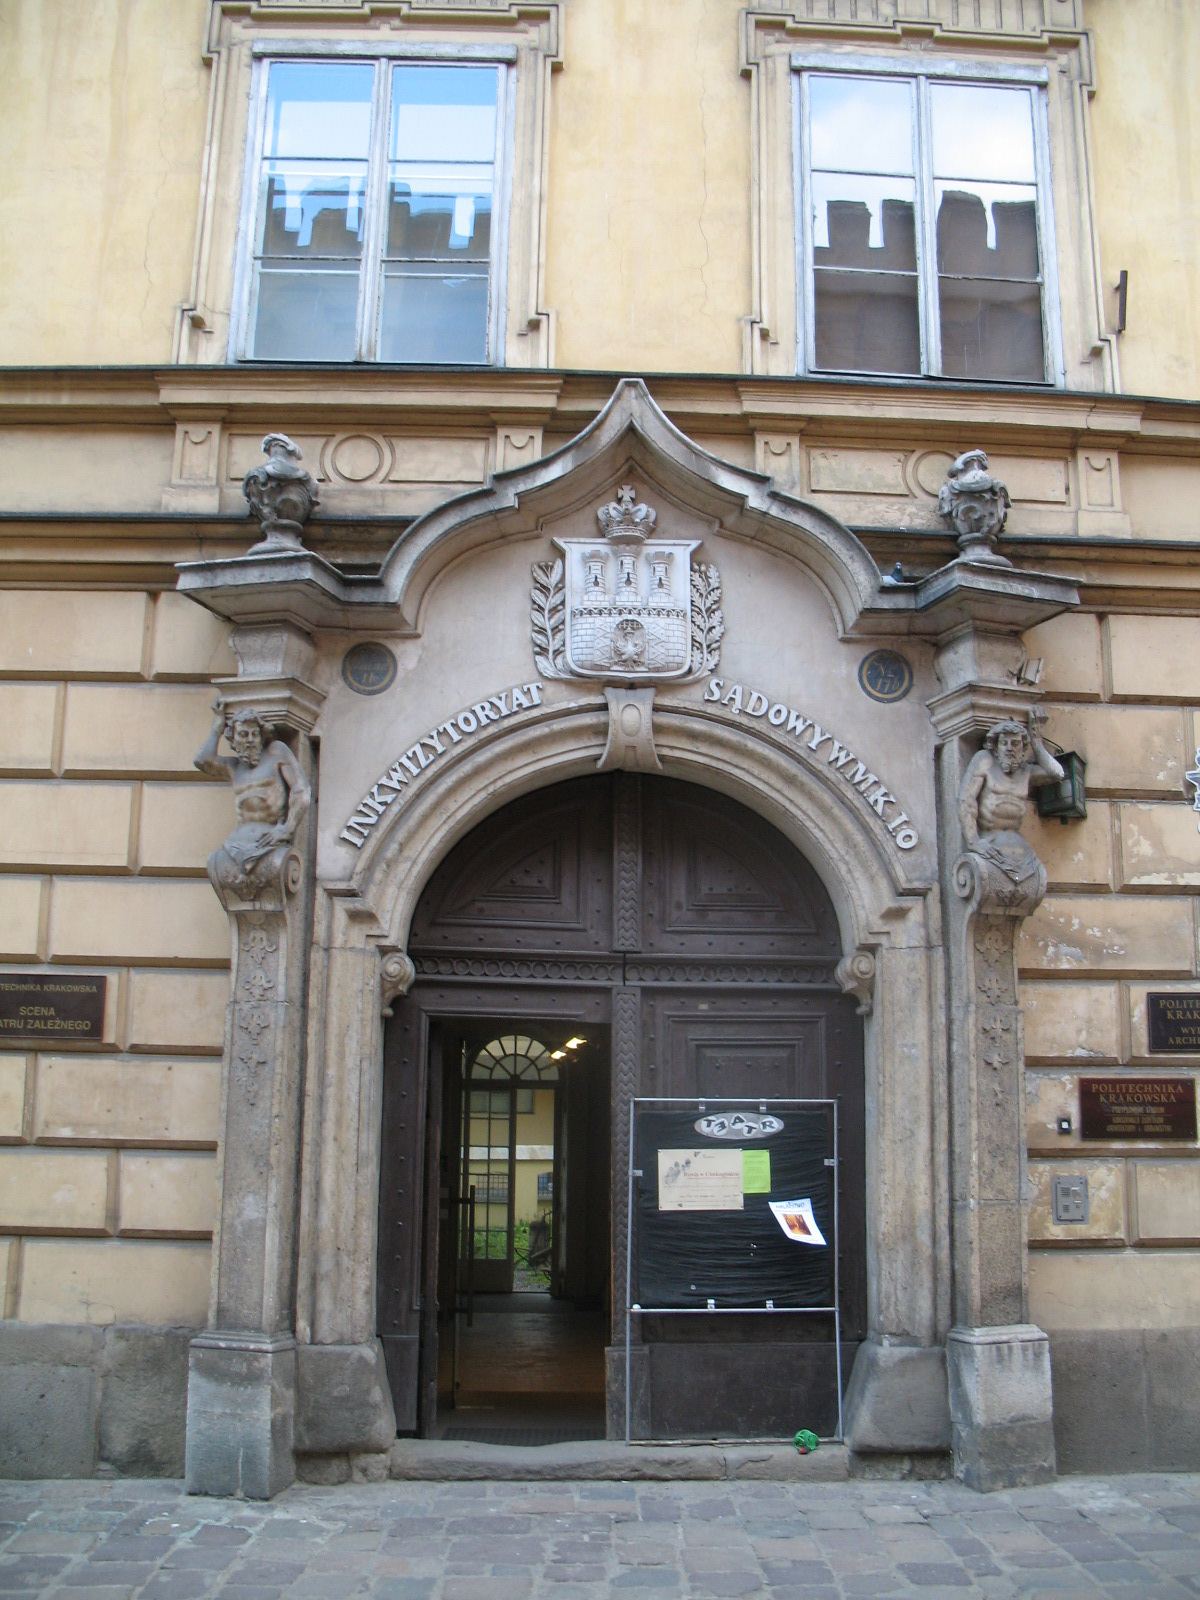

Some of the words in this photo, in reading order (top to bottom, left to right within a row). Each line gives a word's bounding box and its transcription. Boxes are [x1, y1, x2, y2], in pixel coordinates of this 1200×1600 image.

[338, 682, 543, 849] INKWIZYTORYAT
[704, 677, 832, 751] SĄDOWY
[43, 984, 97, 992] KRAKOWSKA
[19, 1006, 55, 1016] SCENA
[27, 1017, 91, 1030] ZALEŻNEGO
[1091, 1084, 1184, 1093] POLITECHNIKA
[1099, 1093, 1177, 1103] KRAKOWSKA
